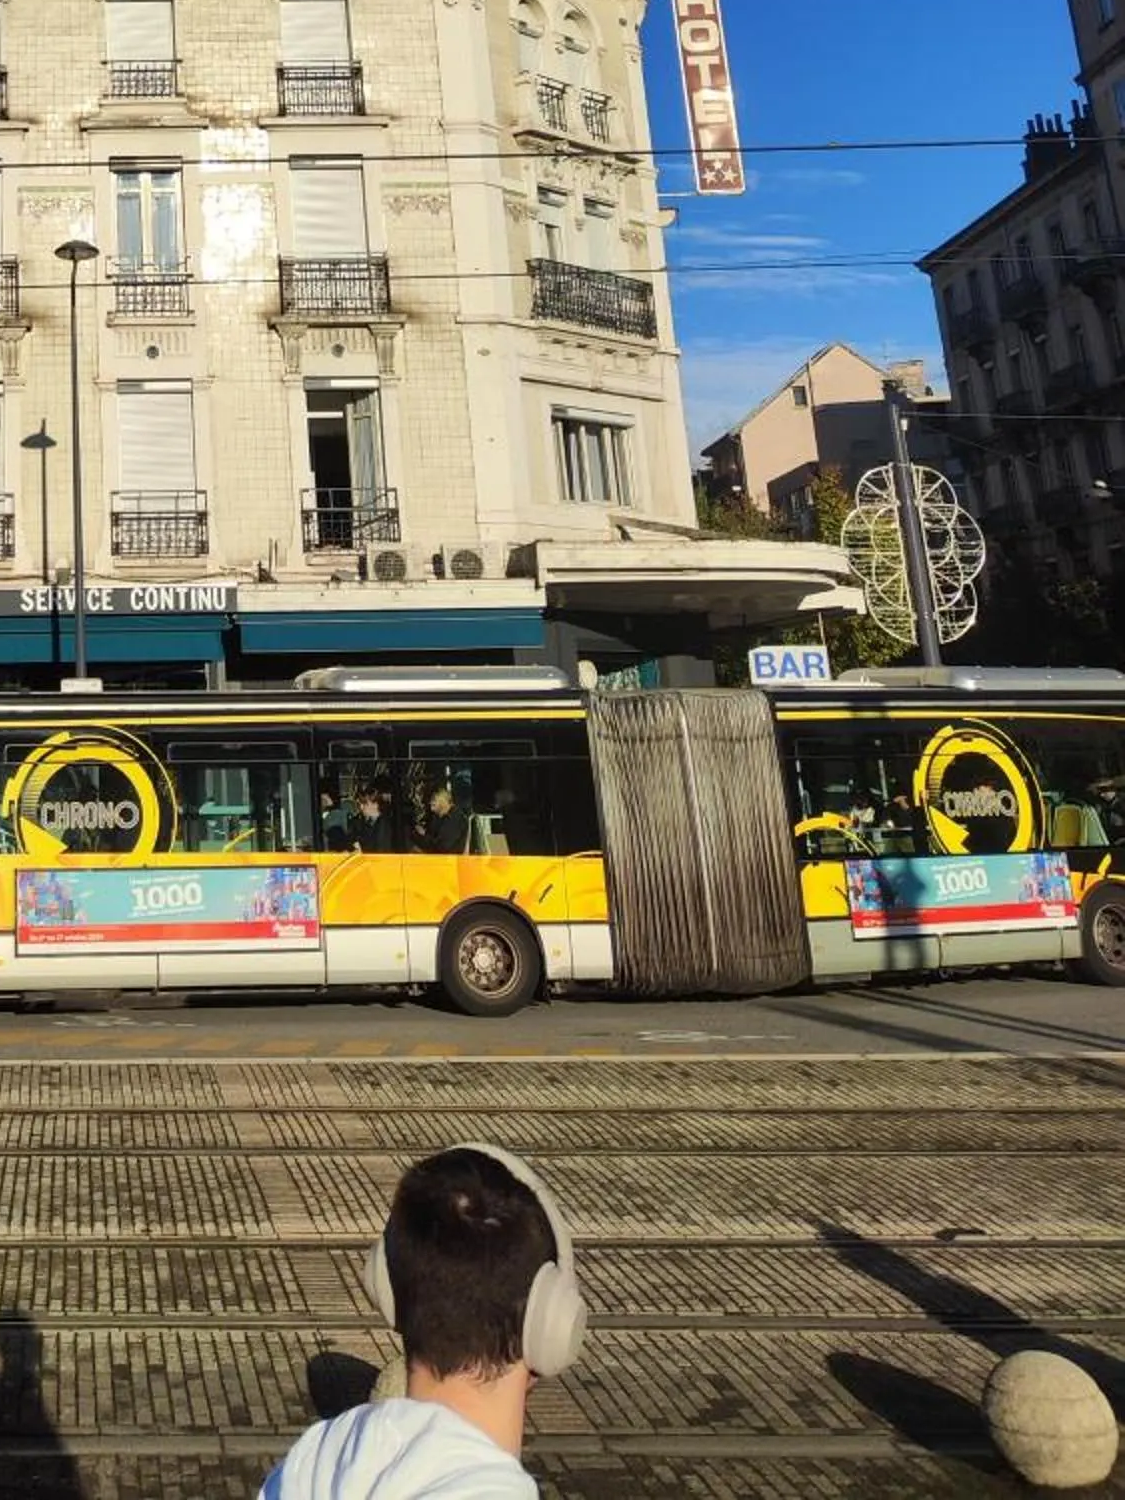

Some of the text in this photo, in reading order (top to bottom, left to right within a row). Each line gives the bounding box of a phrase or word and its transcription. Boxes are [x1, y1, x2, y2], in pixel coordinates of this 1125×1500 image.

[20, 586, 227, 612] SERVCE CONTINU
[754, 651, 826, 679] BAR
[40, 800, 140, 830] CHRONO
[131, 881, 203, 911] 1000
[933, 866, 988, 896] 1000
